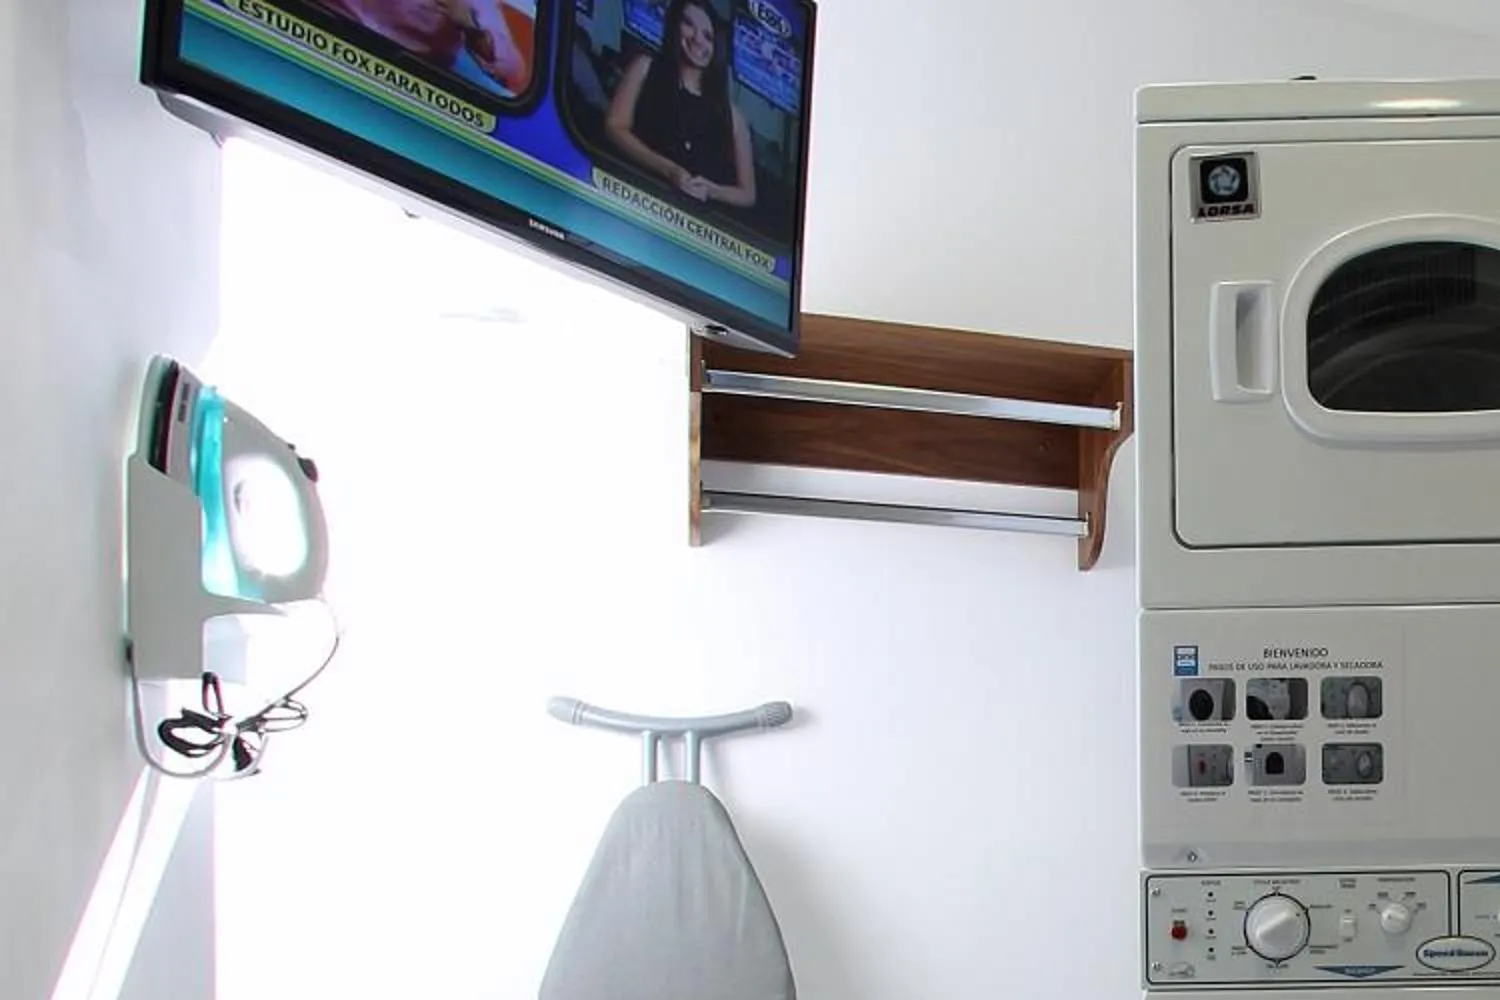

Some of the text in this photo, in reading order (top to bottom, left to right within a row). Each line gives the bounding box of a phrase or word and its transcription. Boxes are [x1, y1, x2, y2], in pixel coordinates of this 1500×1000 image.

[238, 0, 485, 127] ESTUDIO FOX PARA TODOS
[1198, 203, 1256, 218] LORSA
[686, 222, 741, 256] CENTRAL
[743, 247, 769, 269] FOX
[1263, 647, 1329, 659] BIENVENIDO
[1235, 663, 1246, 671] DE
[1247, 663, 1265, 671] USO
[1266, 663, 1288, 671] PARA
[1289, 662, 1332, 670] LAVADORA
